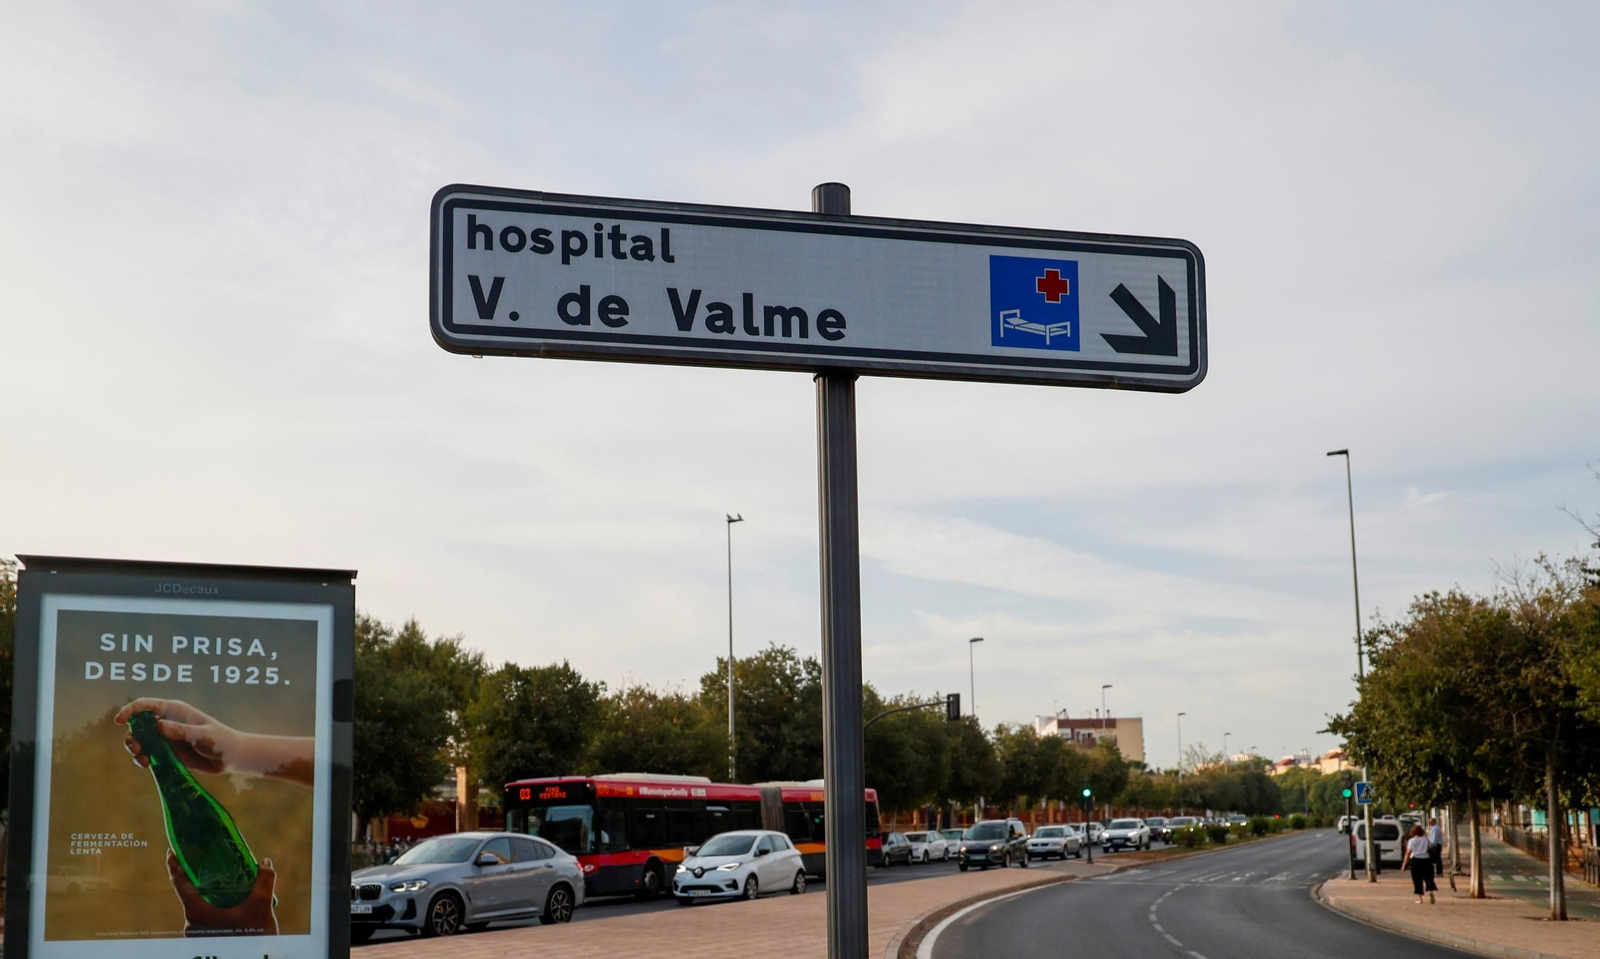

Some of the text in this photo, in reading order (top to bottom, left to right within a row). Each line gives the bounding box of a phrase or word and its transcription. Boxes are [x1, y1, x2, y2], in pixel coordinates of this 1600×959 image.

[467, 214, 676, 265] hospital
[467, 274, 847, 341] V. de Valme
[154, 582, 220, 595] JCDecaux
[100, 632, 279, 660] SIN PRISA,
[85, 661, 291, 686] DESDE 1925.
[520, 788, 531, 800] 03
